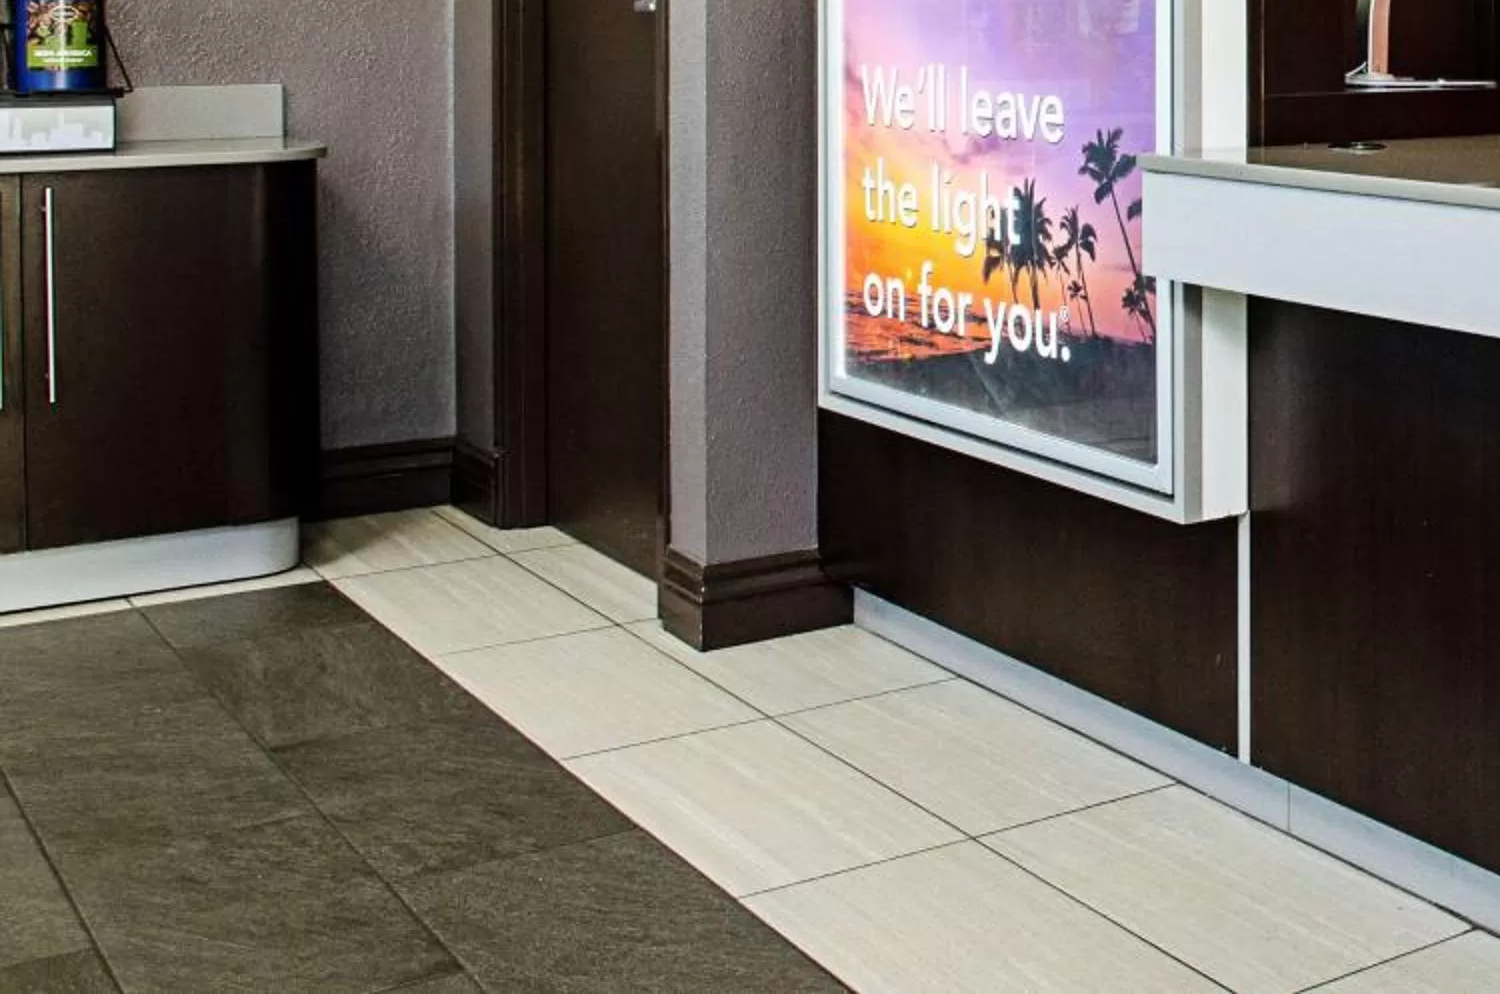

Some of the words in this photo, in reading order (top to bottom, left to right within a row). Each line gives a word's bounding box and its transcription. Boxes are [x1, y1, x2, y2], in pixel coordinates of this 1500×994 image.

[861, 62, 946, 133] We'll
[960, 65, 1067, 144] leave
[862, 156, 919, 228] the
[930, 159, 1022, 258] light
[862, 270, 907, 322] on
[915, 260, 973, 336] for
